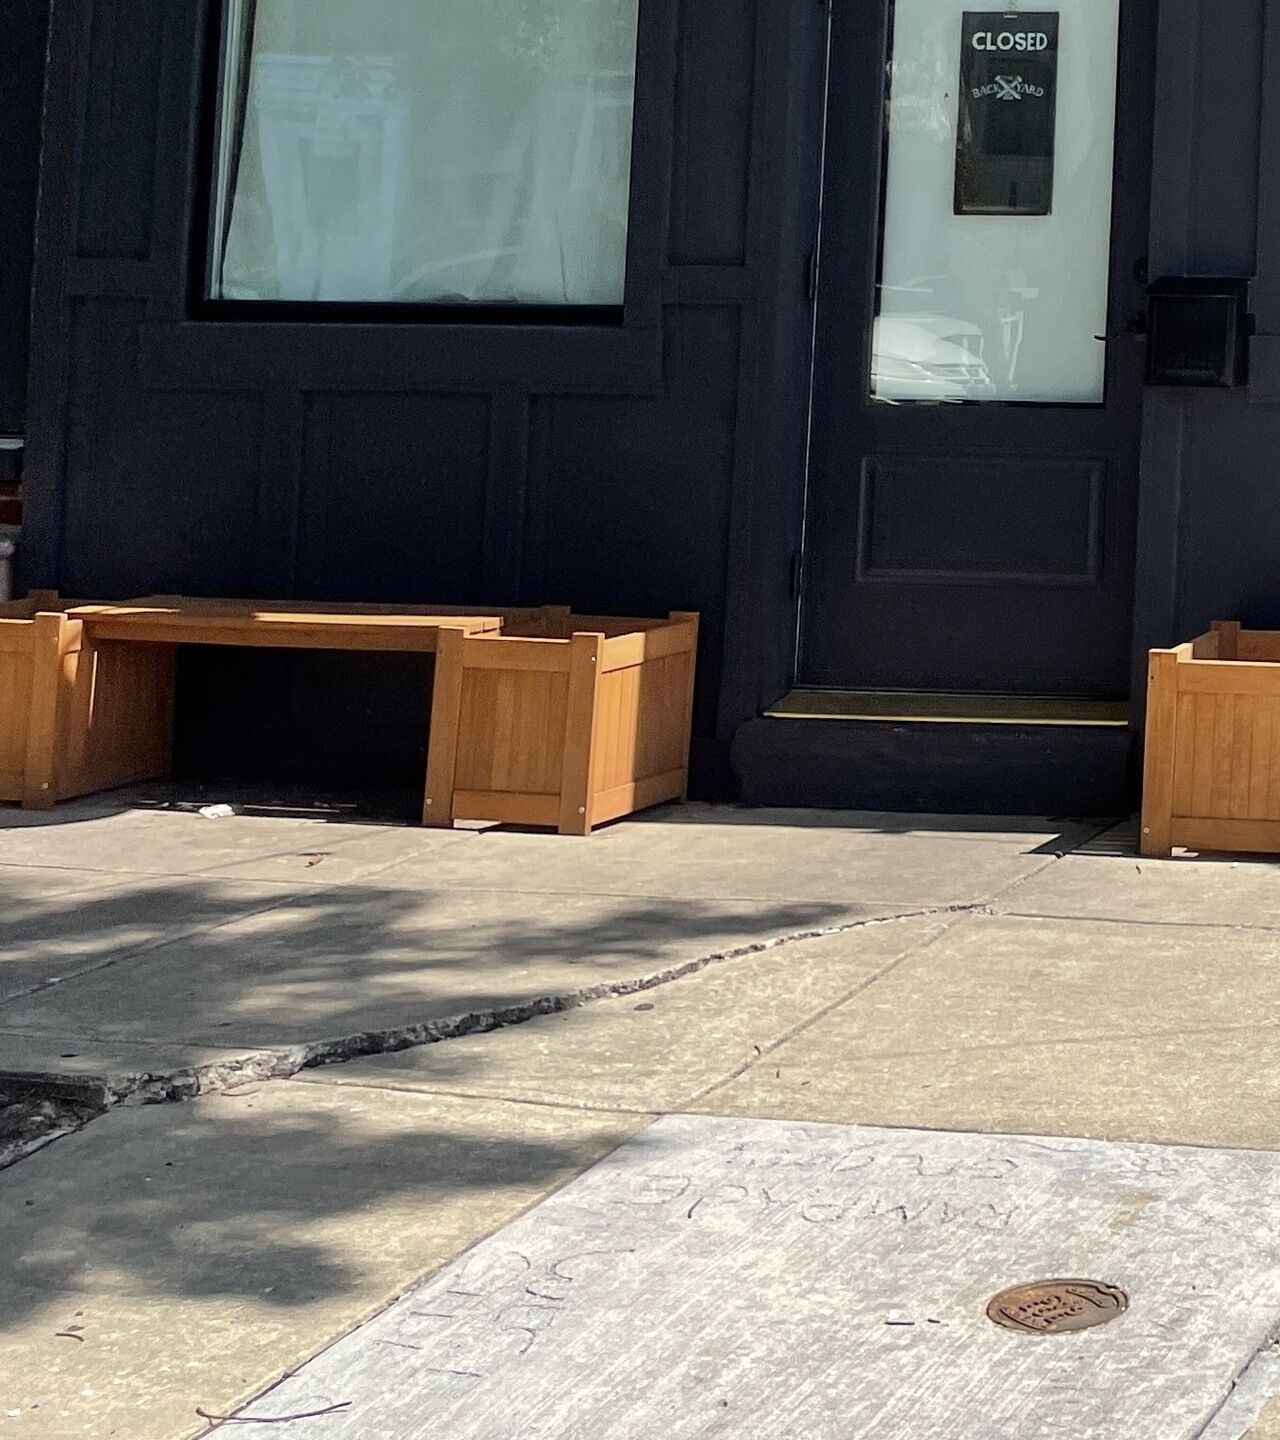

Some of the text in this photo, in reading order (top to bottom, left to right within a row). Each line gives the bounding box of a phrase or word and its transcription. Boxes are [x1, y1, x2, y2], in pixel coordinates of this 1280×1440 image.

[971, 31, 1048, 51] CLOSED
[971, 83, 1044, 99] BACK YARD
